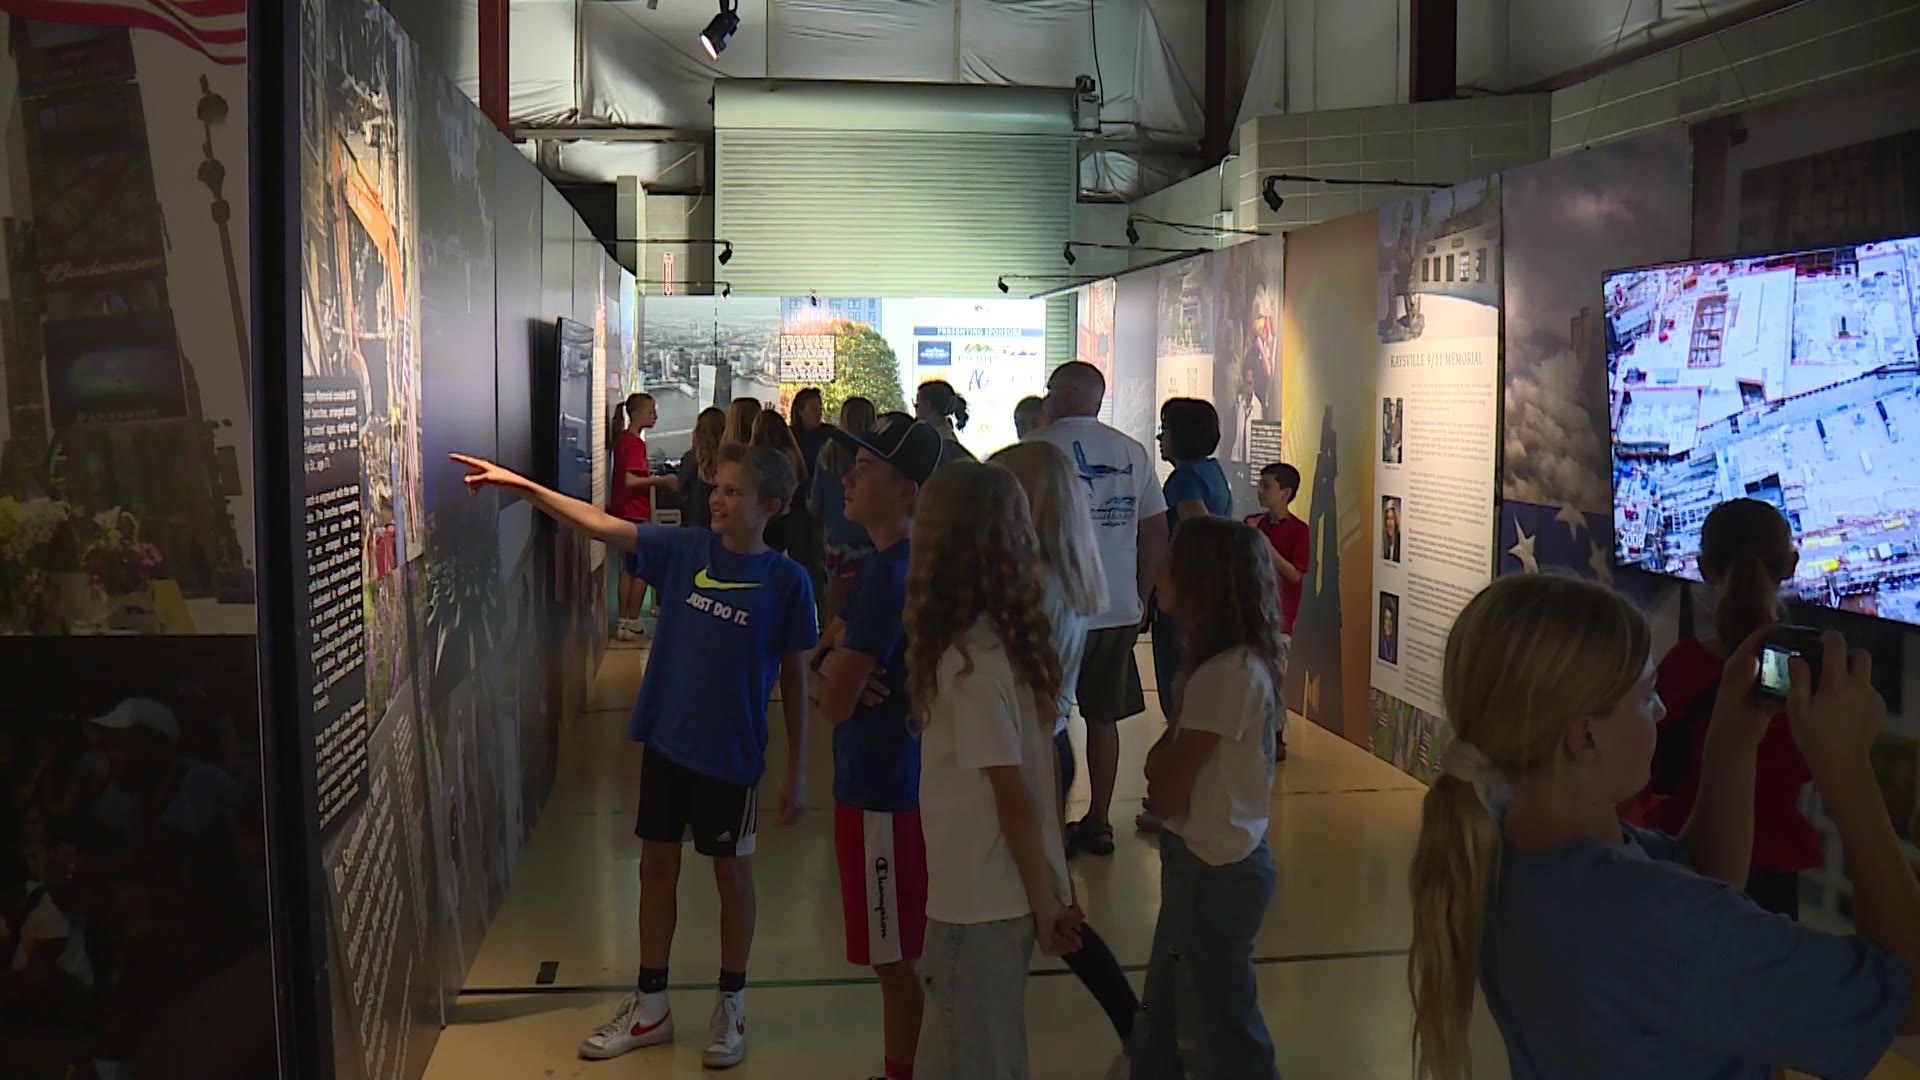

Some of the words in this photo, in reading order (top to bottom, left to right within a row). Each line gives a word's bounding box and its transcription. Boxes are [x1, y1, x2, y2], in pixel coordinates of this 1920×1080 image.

[40, 256, 162, 284] Budweiser
[937, 327, 983, 336] PRESENTING
[985, 327, 1022, 336] SPONSORS
[1390, 353, 1425, 368] KAYSVILLE
[1427, 353, 1443, 370] 9/11
[1445, 351, 1483, 366] MEMORIAL
[1620, 531, 1645, 548] 2008
[686, 592, 713, 612] JUST
[713, 601, 732, 620] DO
[874, 857, 888, 939] Champion
